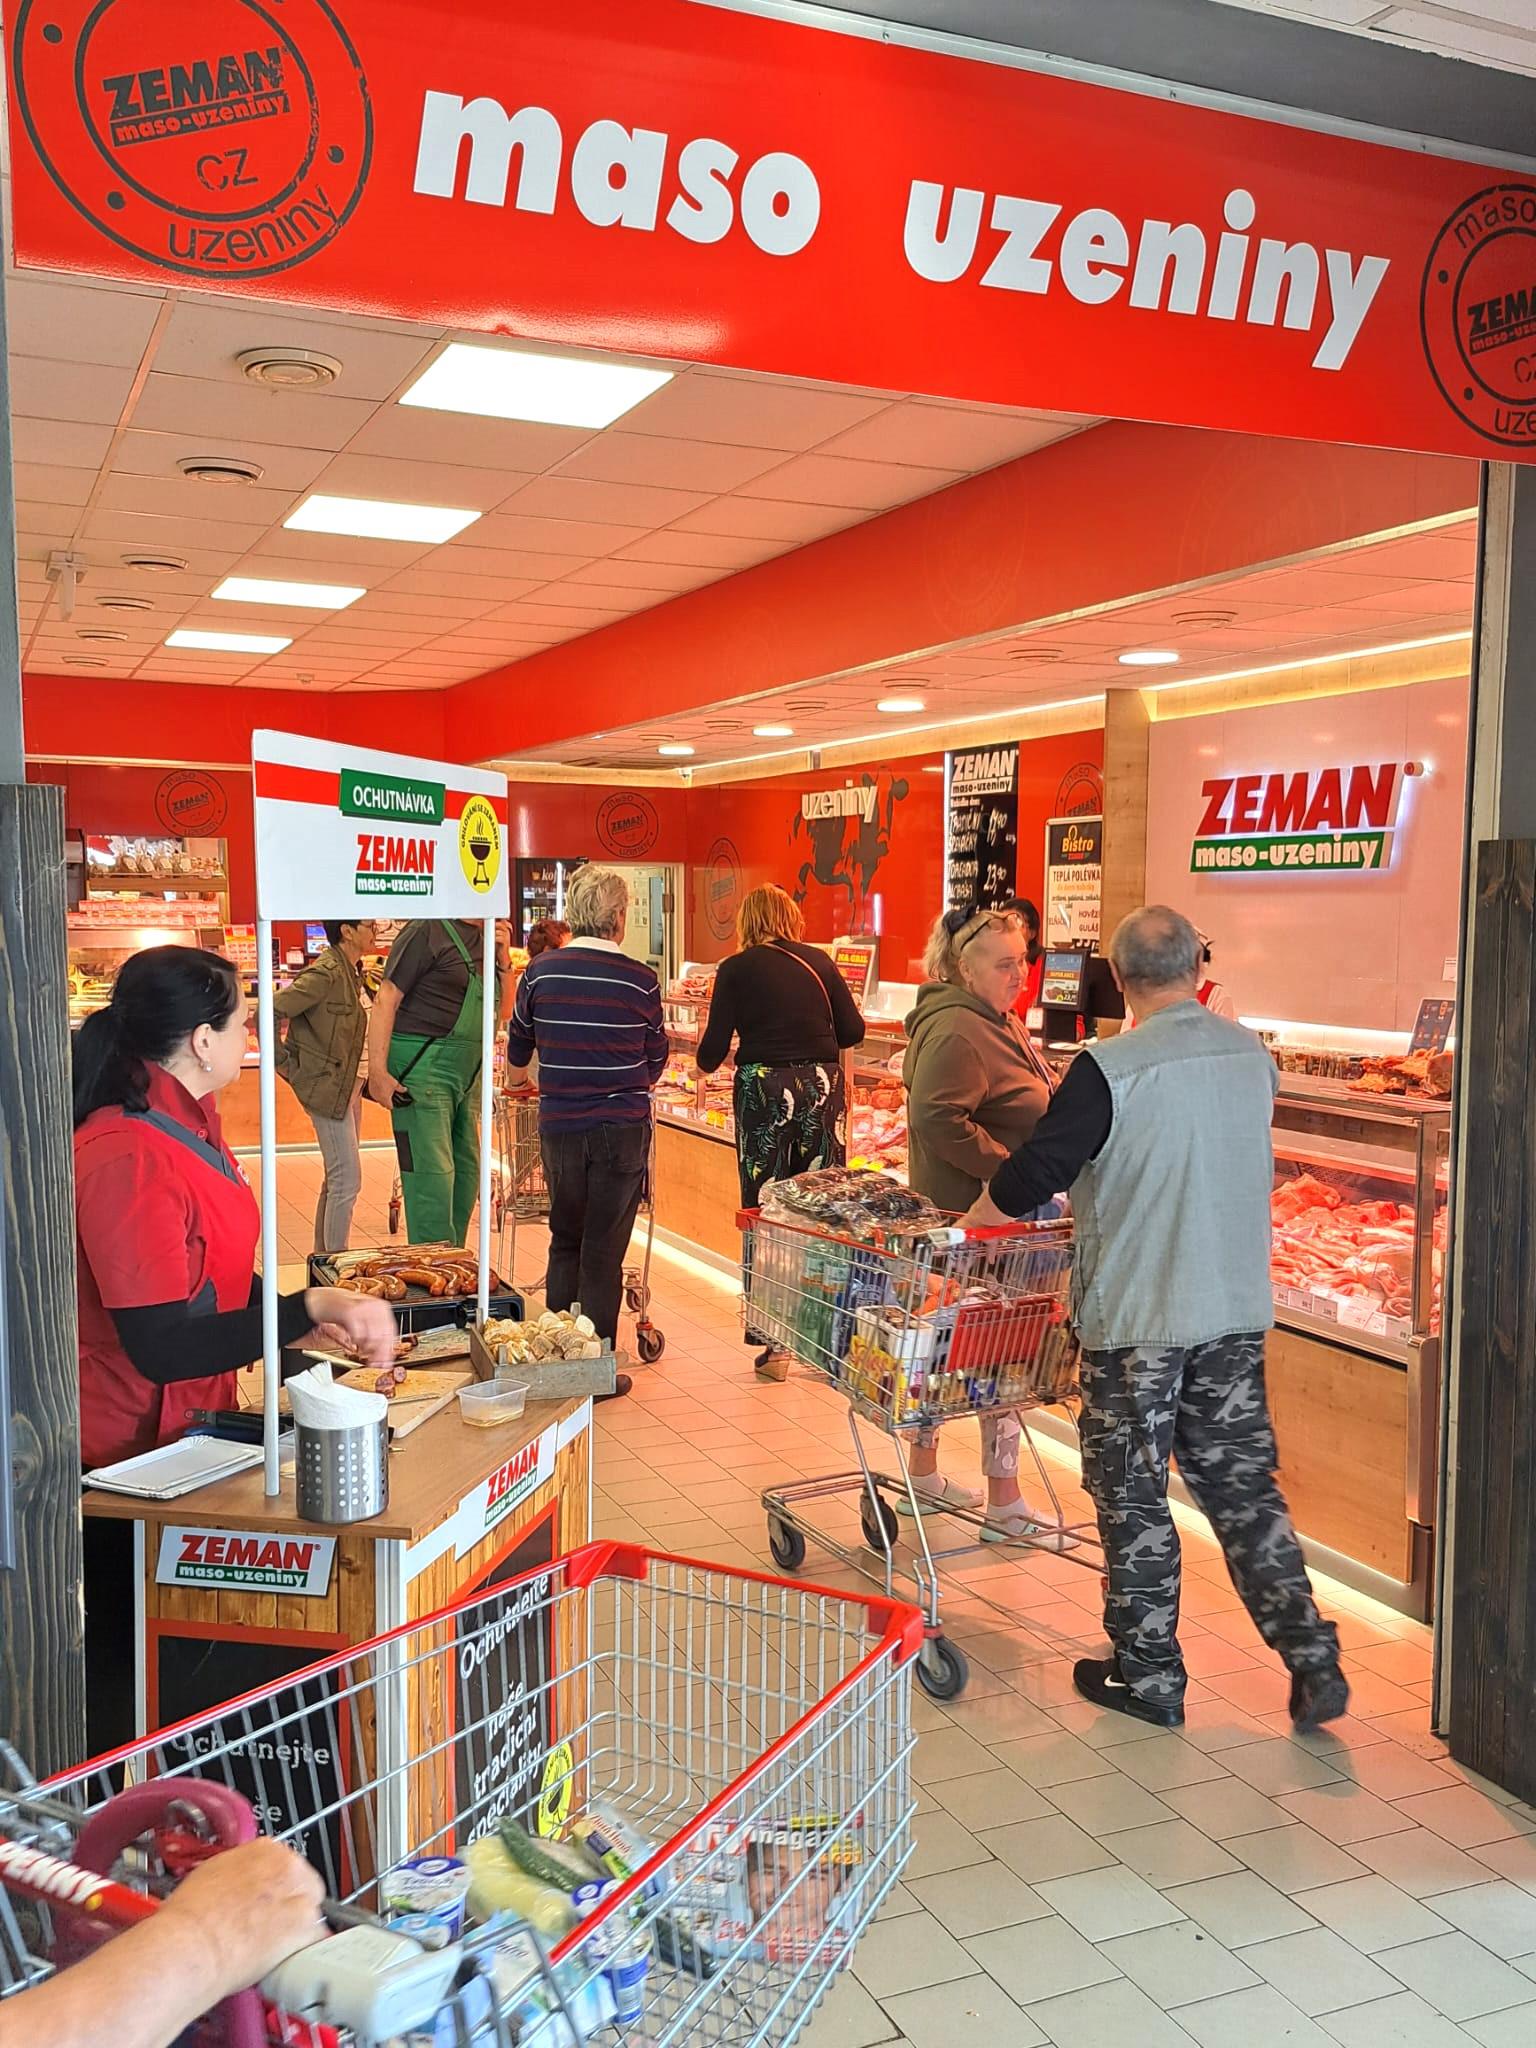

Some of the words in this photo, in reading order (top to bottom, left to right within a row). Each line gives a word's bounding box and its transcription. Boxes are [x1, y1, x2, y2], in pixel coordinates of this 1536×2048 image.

[103, 47, 286, 121] ZEMAN
[114, 94, 290, 147] maso-uzeniny
[197, 149, 258, 191] CZ
[168, 184, 338, 265] uzeniny
[413, 89, 821, 256] maso
[903, 180, 1390, 370] uzeniny
[952, 776, 1011, 793] maso-uzeniny
[953, 749, 1016, 781] ZEMAN
[352, 784, 435, 815] OCHUTNÁVKA
[802, 780, 877, 823] uzeniny
[1196, 763, 1397, 836] ZEMAN
[356, 833, 434, 874] ZEMAN
[1062, 836, 1094, 853] Bistro
[1195, 834, 1379, 869] maso-uzeniny
[357, 874, 433, 896] maso-uzeniny
[486, 1438, 540, 1507] ZEMAN
[179, 1534, 314, 1570] ZEMAN
[179, 1564, 304, 1587] maso-uzeniny
[474, 1693, 537, 1800] tradiční
